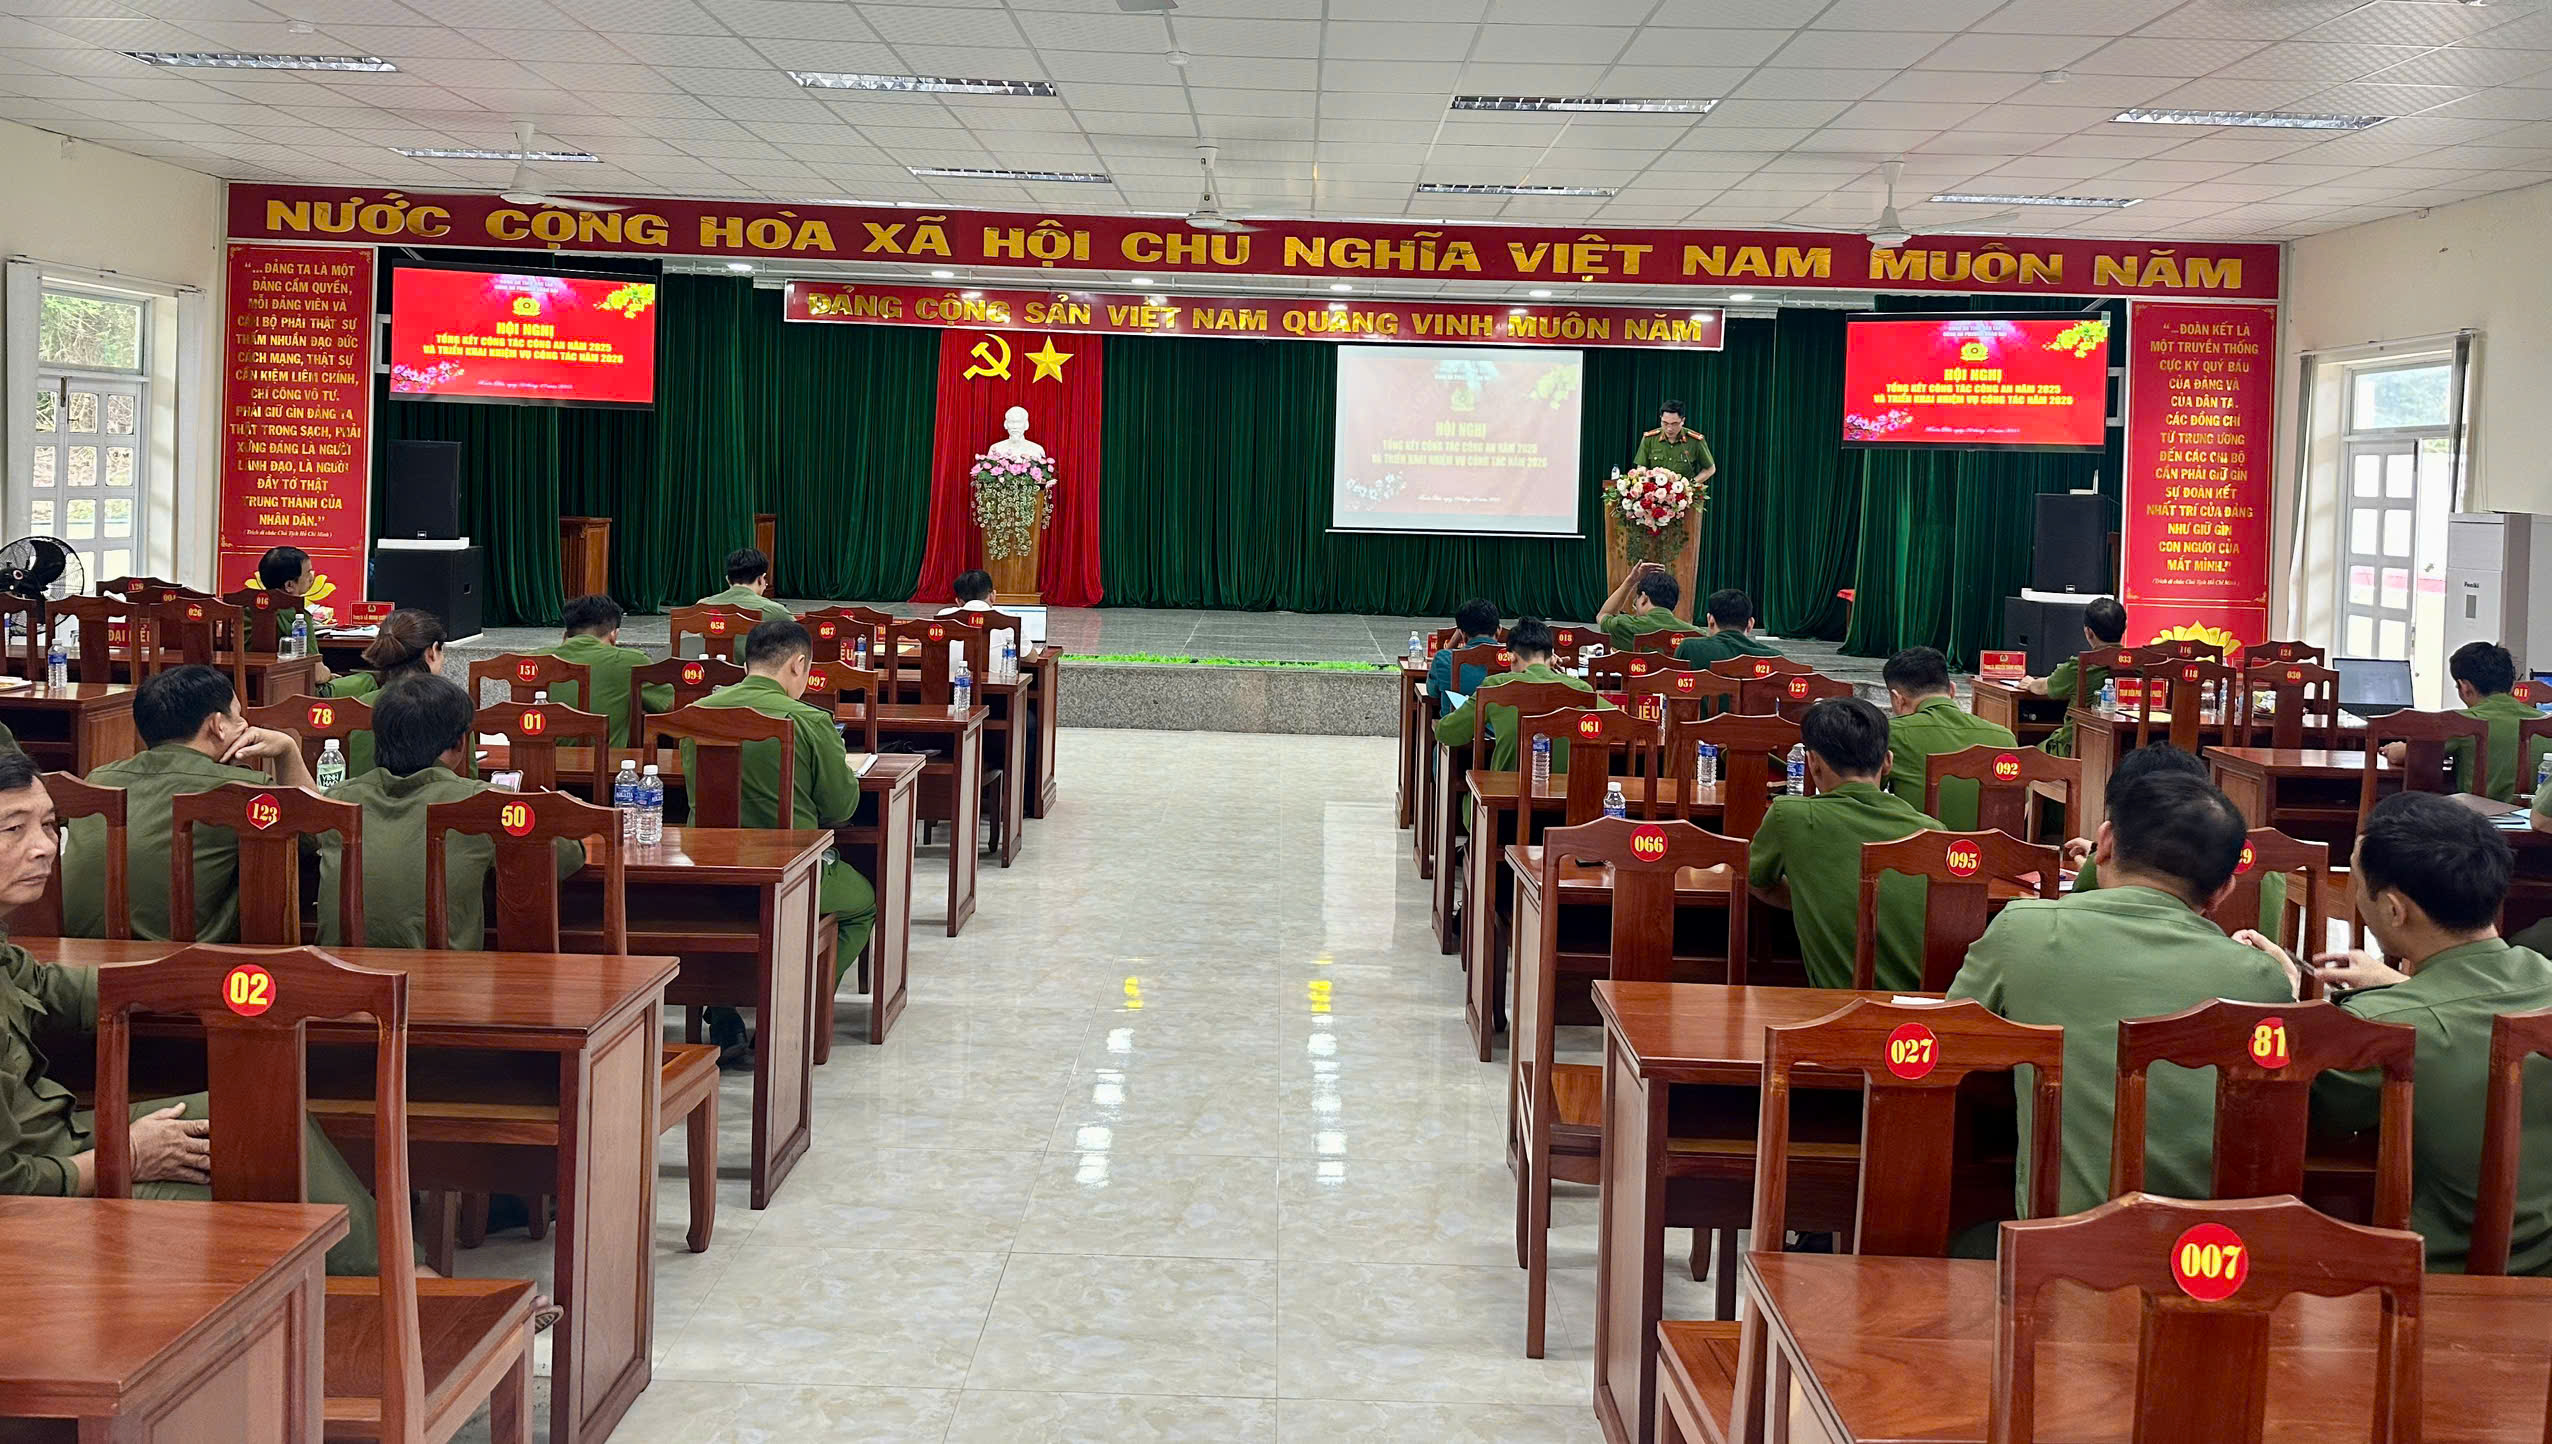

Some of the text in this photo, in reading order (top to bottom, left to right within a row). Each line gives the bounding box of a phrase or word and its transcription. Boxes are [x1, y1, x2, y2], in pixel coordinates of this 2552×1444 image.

[265, 193, 451, 237] NƯỚC
[699, 210, 836, 251] HÒA
[862, 215, 952, 257] XÃ
[983, 219, 1091, 267] HỘI
[1284, 231, 1482, 273] NGHĨA
[1507, 234, 1653, 282] VIỆT
[1682, 244, 1830, 279] NAM
[1869, 242, 2063, 284] MUÔN
[2091, 248, 2242, 289] NĂM
[297, 262, 355, 278] TA LÀ MỘT
[253, 277, 281, 292] ĐẢNG
[272, 295, 347, 311] ĐẢNG VIÊN VÀ
[808, 285, 1702, 342] ĐẢNG CỘNG SẢN VIỆT NAM QUANG VINH MUÔN NĂM
[263, 314, 277, 329] BỘ
[281, 315, 306, 328] PHẢI
[310, 316, 336, 331] THẬT
[496, 321, 518, 337] HỘI
[2213, 321, 2250, 336] KẾT LÀ
[589, 342, 612, 352] 2025
[2151, 339, 2174, 354] MỘT
[307, 352, 334, 368] THẬT
[261, 369, 288, 384] KIỆM
[1944, 367, 1967, 382] HỘI
[2169, 375, 2190, 389] CỦA
[2194, 375, 2223, 390] ĐẢNG
[272, 387, 301, 400] CÔNG
[304, 387, 318, 400] VÔ
[2196, 394, 2217, 408] DÂN
[307, 404, 336, 419] ĐẢNG
[2166, 411, 2187, 425] CÁC
[263, 425, 297, 436] TRONG
[2178, 433, 2213, 444] TRUNG
[302, 442, 315, 455] LÀ
[2185, 449, 2206, 462] CÁC
[2231, 450, 2245, 466] BỘ
[299, 460, 312, 472] LÀ
[2181, 465, 2206, 480] PHẢI
[300, 479, 328, 493] THẬT
[321, 494, 342, 509] CỦA
[2200, 501, 2222, 517] CỦA
[2225, 503, 2253, 518] ĐẢNG
[259, 512, 289, 526] NHÂN
[2159, 541, 2180, 552] CON
[929, 627, 944, 638] 019
[519, 664, 535, 676] 151
[1630, 663, 1647, 673] 063
[1755, 664, 1770, 674] 021
[807, 676, 826, 688] 097
[1790, 683, 1807, 693] 127
[311, 702, 333, 725] 78
[523, 713, 541, 730] 01
[1580, 721, 1599, 733] 061
[1995, 761, 2020, 776] 092
[251, 803, 278, 822] 123
[501, 804, 526, 828] 50
[1634, 835, 1665, 853] 066
[1948, 851, 1979, 870] 095
[229, 971, 269, 1006] 02
[2253, 1024, 2287, 1057] 81
[1890, 1037, 1937, 1065] 027
[2180, 1243, 2243, 1280] 007
